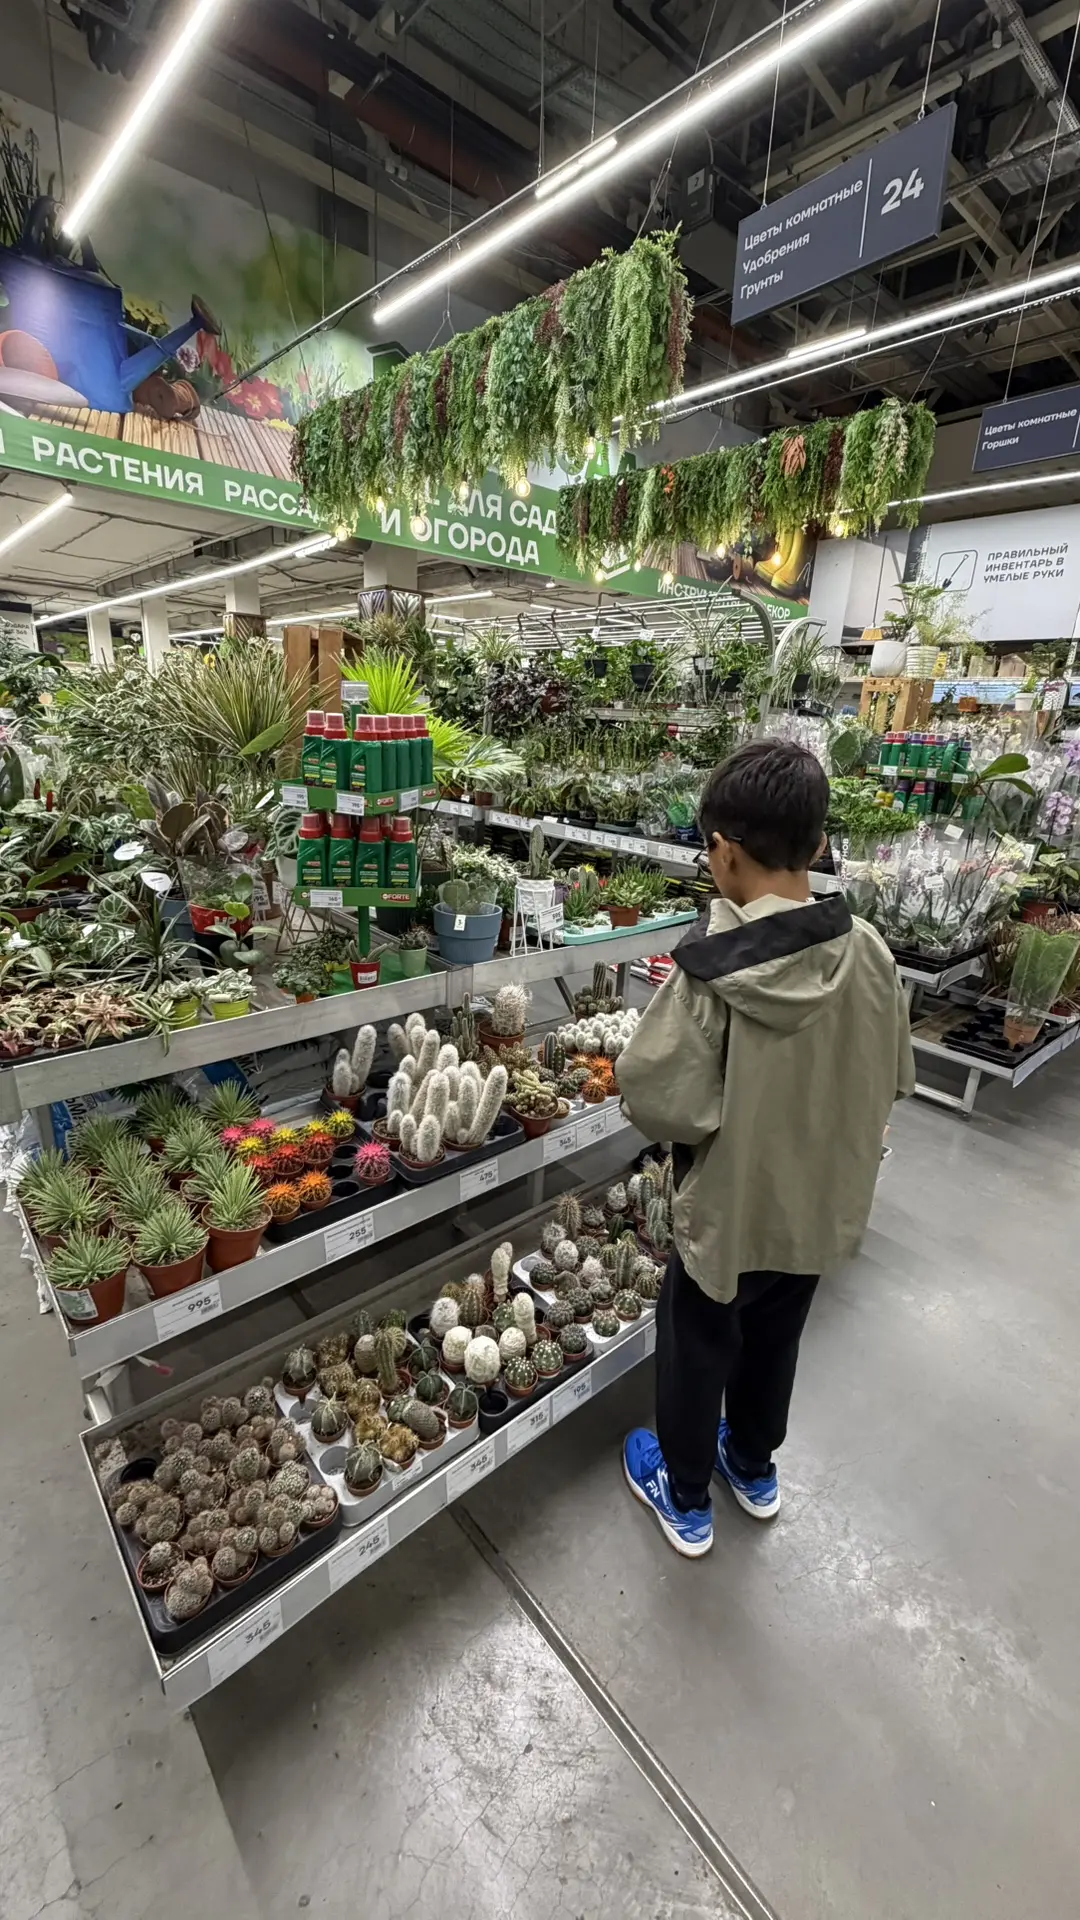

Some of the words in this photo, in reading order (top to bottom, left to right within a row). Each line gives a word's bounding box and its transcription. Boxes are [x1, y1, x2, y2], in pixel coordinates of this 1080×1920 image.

[880, 167, 925, 216] 24
[744, 222, 783, 251] Цветы
[785, 179, 864, 230] комнатные
[742, 232, 810, 275] Удобрения
[740, 270, 784, 300] Грунты
[984, 422, 1016, 436] Цветы
[1017, 409, 1078, 429] комнатные
[981, 436, 1020, 451] Горшки
[31, 435, 204, 496] РАСТЕНИЯ
[381, 508, 402, 537] И
[411, 515, 540, 566] ОГОРОДА
[987, 542, 1069, 561] ПРАВИЛЬНЫЙ
[985, 558, 1053, 572] ИНВЕНТАРЬ
[1055, 557, 1065, 566] В
[983, 571, 1030, 583] УМЕЛЫЕ
[1032, 568, 1065, 579] РУКИ
[349, 1227, 367, 1240] 255
[188, 1296, 212, 1313] 995
[573, 1382, 587, 1396] 195
[530, 1411, 545, 1426] 315
[646, 1480, 660, 1497] FN
[359, 1535, 380, 1557] 245
[245, 1620, 272, 1644] 345
